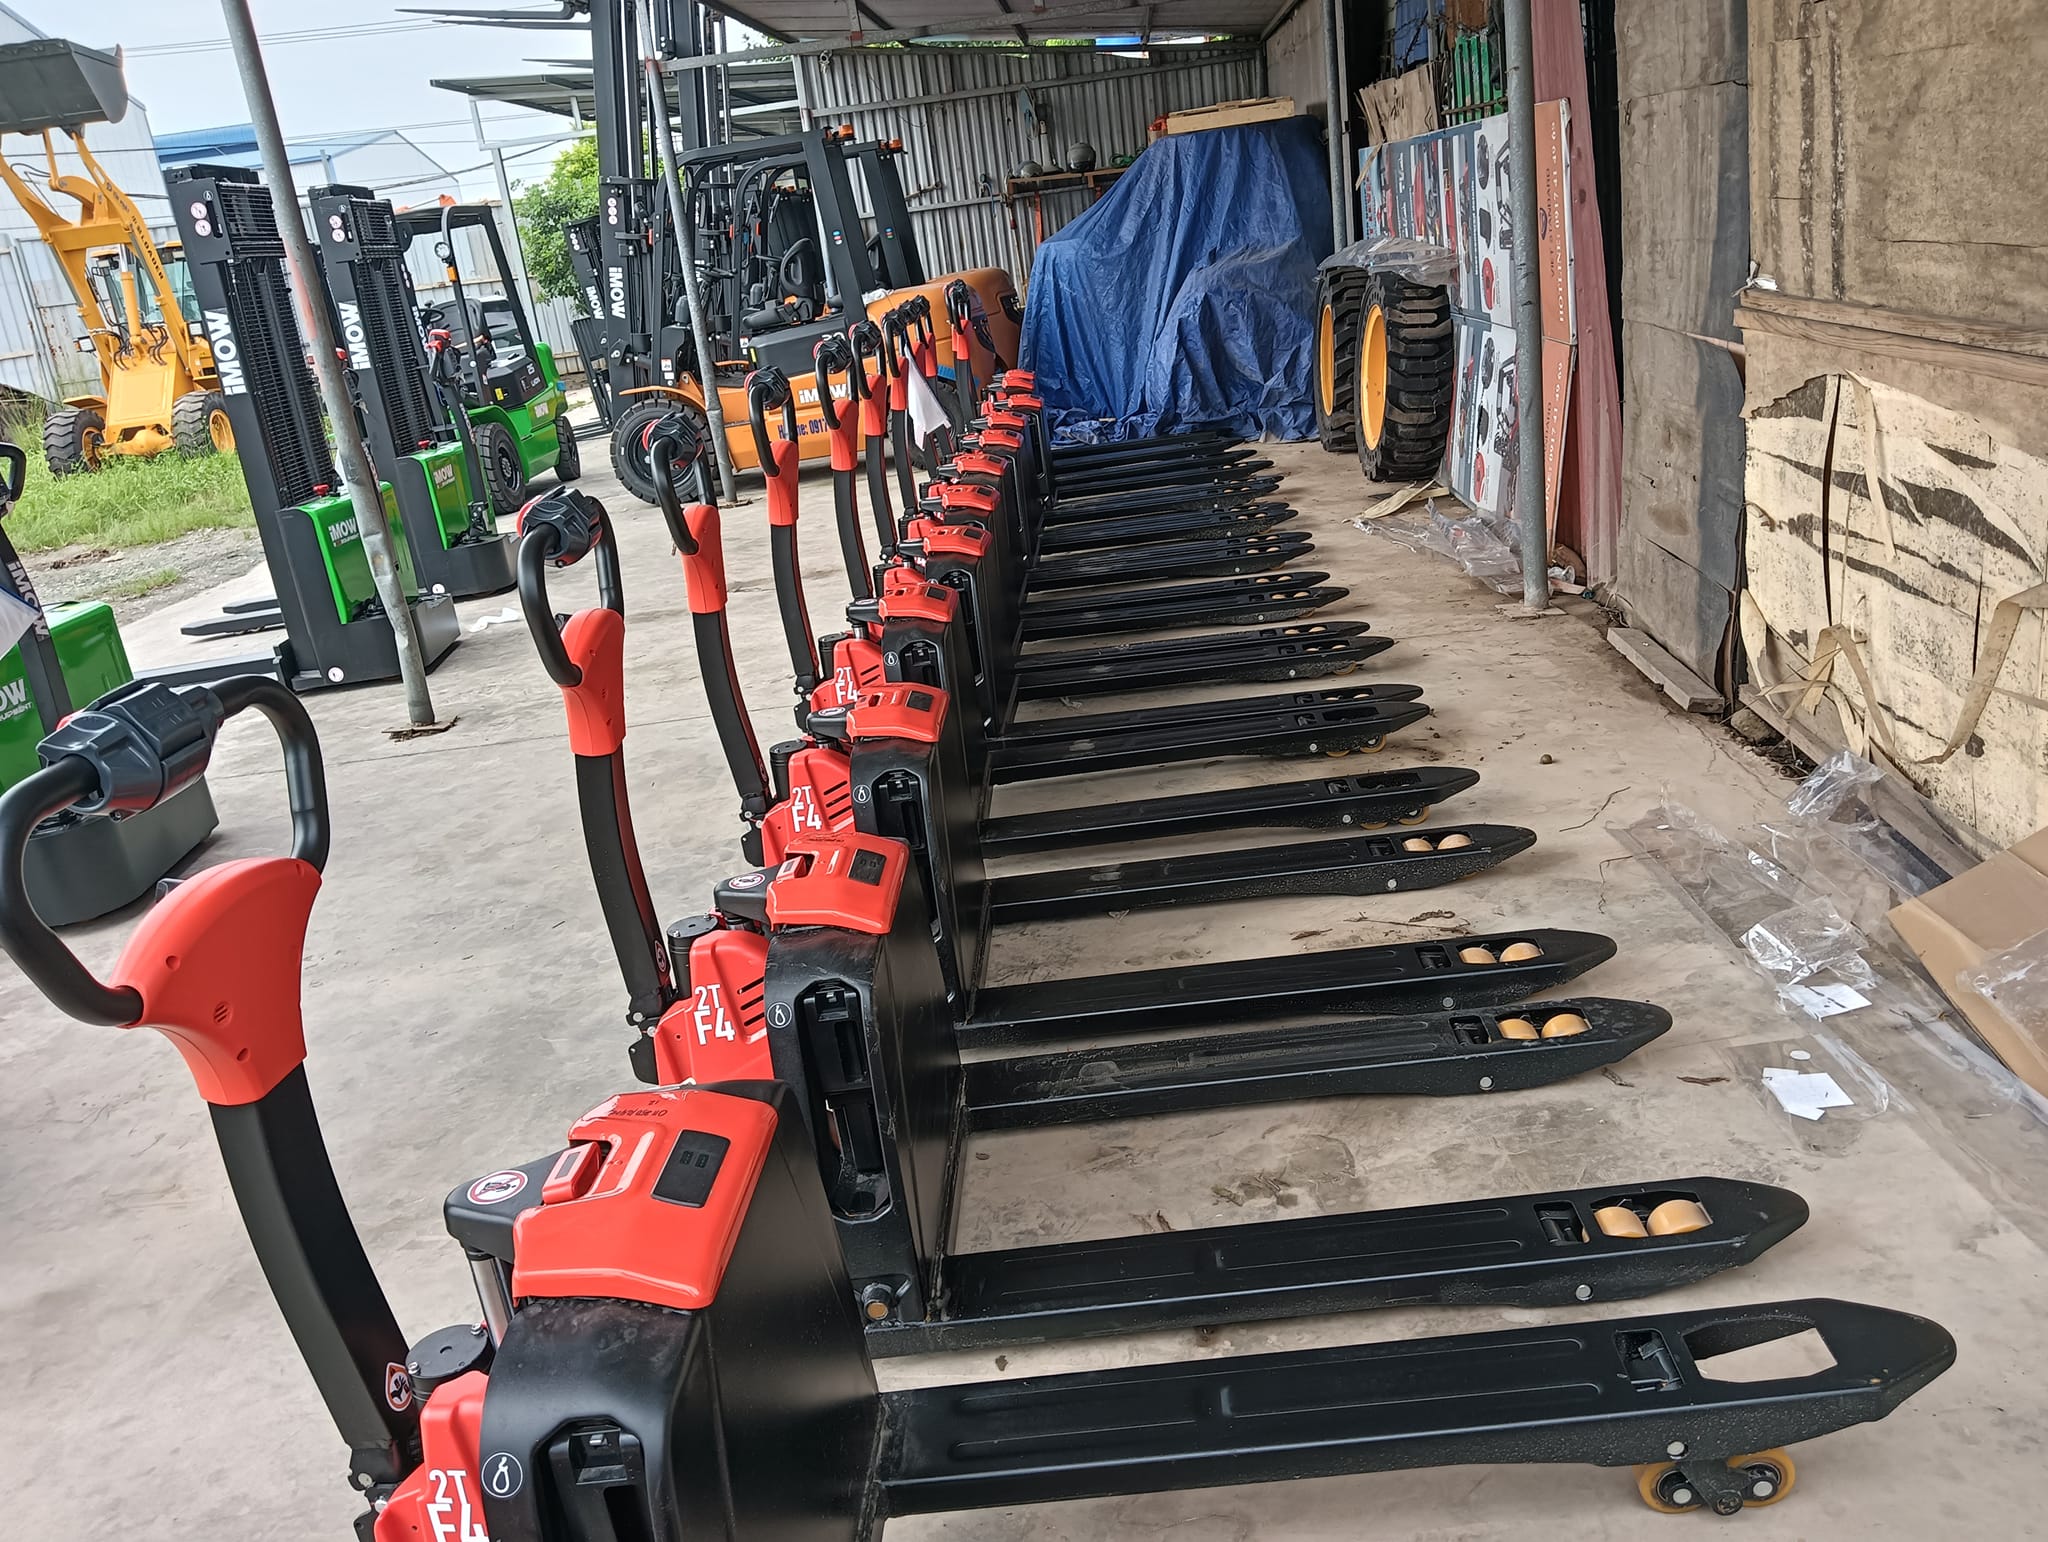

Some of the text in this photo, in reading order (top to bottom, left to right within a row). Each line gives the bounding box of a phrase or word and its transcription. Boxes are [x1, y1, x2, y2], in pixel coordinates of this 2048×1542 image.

[585, 285, 605, 320] iMOW
[608, 267, 626, 319] iMOW
[203, 307, 248, 396] iMOW
[338, 302, 371, 370] iMOW
[798, 384, 847, 404] iMW
[328, 518, 358, 541] iMOW
[836, 666, 852, 683] 2T
[835, 681, 858, 704] F4
[792, 785, 812, 806] 2T
[791, 803, 822, 832] F4
[694, 983, 721, 1010] 2T
[693, 1007, 736, 1045] F4
[429, 1469, 467, 1504] 2T
[426, 1503, 491, 1542] F4
